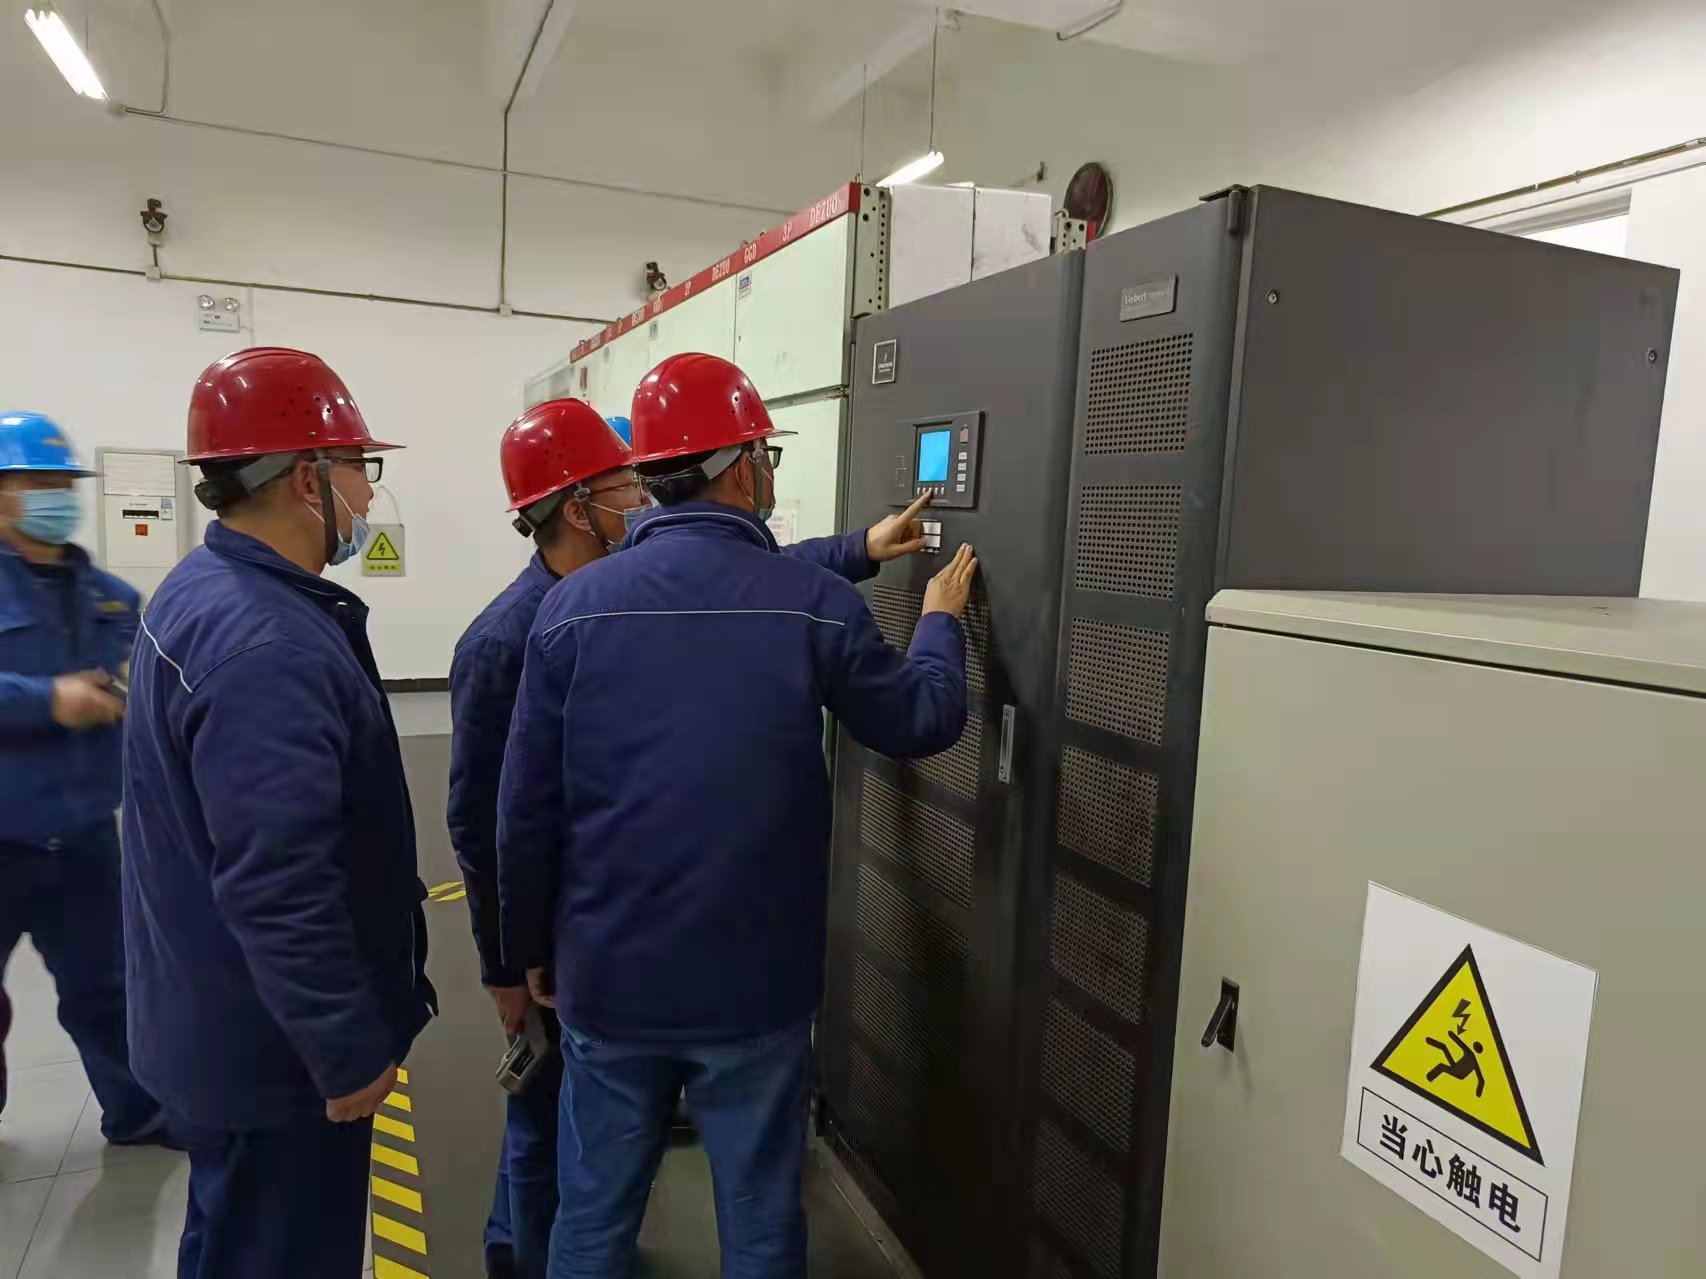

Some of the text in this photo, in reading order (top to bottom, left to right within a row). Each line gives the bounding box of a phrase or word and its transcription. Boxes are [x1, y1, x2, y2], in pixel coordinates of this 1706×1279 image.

[744, 243, 757, 264] GGD
[809, 193, 838, 227] DEZUO
[1379, 1113, 1521, 1233] 当心触电
